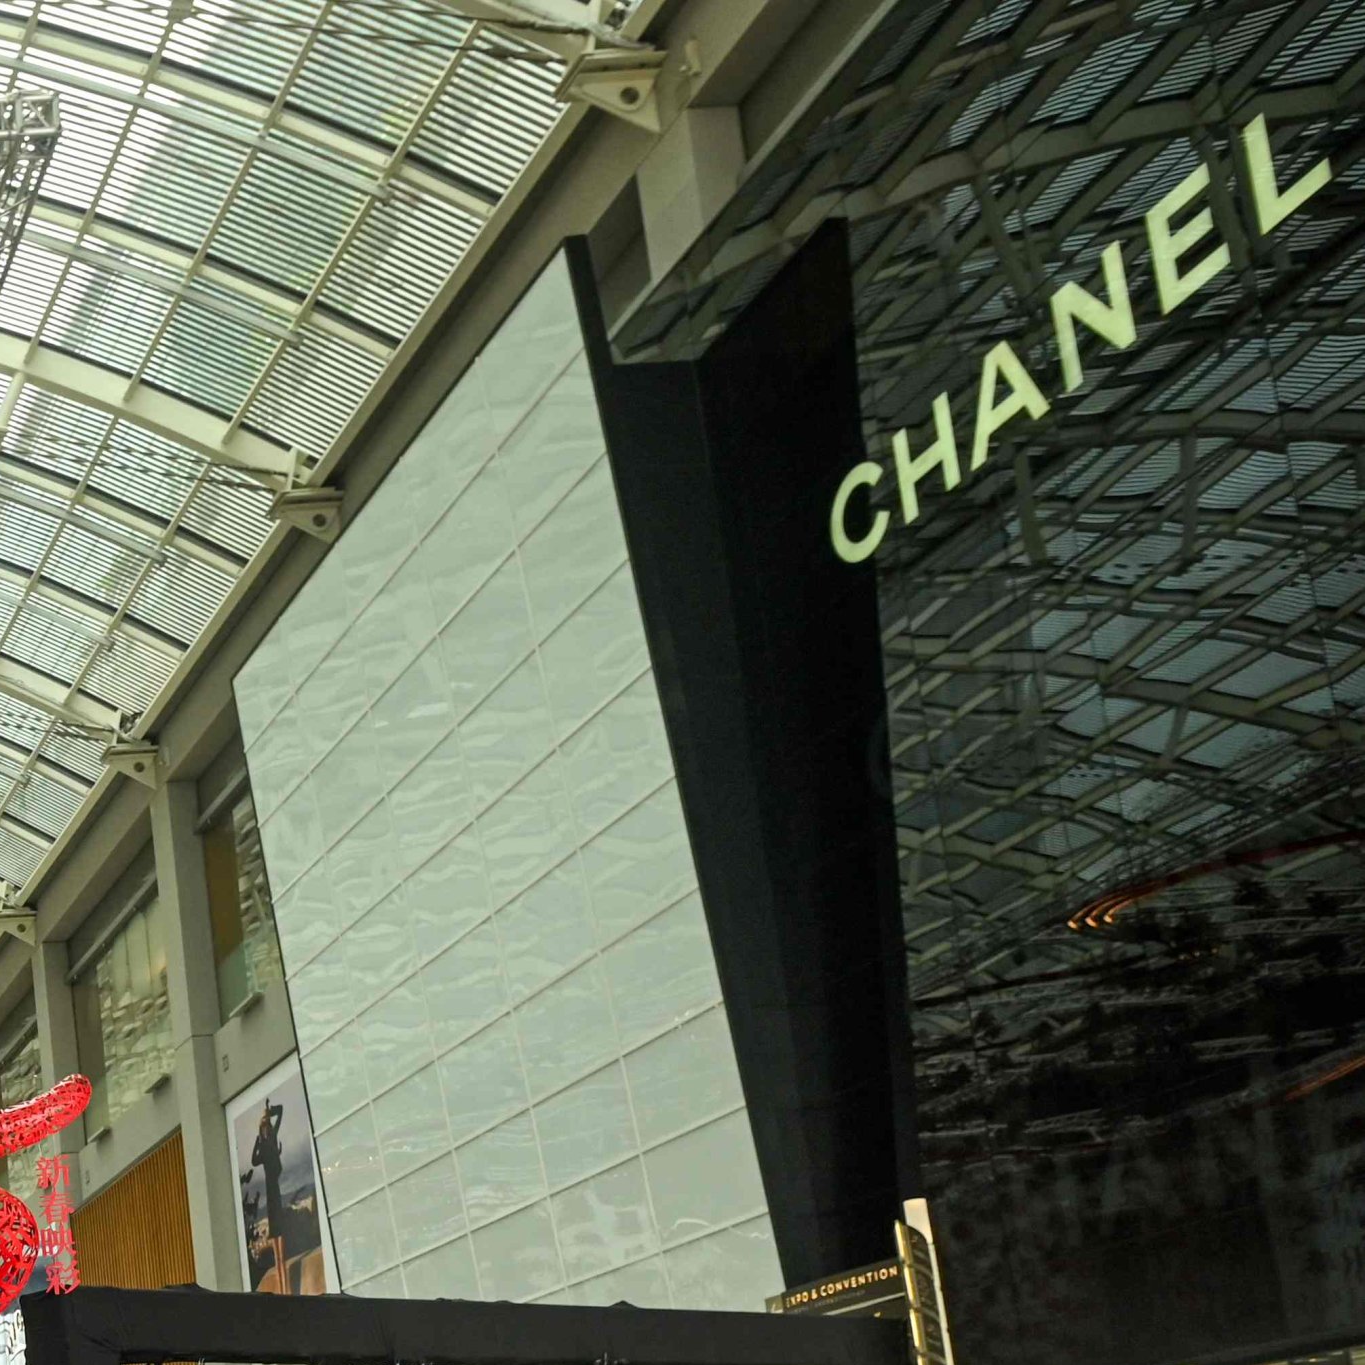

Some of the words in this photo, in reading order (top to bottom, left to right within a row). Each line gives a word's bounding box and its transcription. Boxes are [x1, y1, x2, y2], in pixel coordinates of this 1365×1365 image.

[830, 113, 1333, 563] CHANEL
[36, 1153, 81, 1296] 新春映彩
[811, 1289, 818, 1300] &
[820, 1265, 898, 1296] CONVENTION
